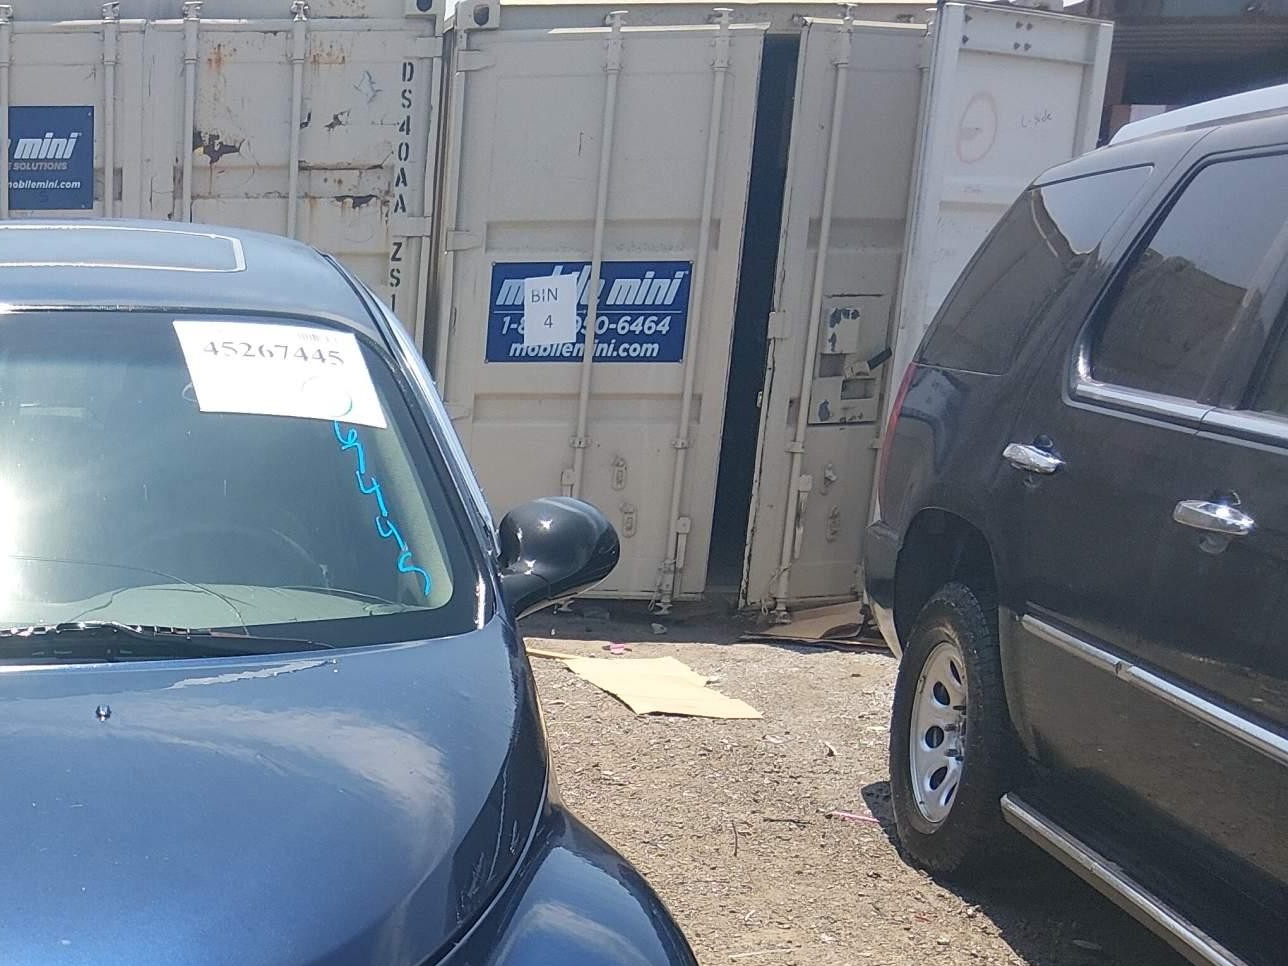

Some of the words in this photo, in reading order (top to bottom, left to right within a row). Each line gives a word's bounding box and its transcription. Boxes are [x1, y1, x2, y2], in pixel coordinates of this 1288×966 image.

[14, 132, 79, 160] mini
[393, 62, 414, 214] DS40AA
[13, 161, 68, 171] SOLUTIONS
[531, 287, 558, 304] BIN
[606, 271, 683, 306] mini
[543, 314, 553, 329] 4
[203, 340, 344, 366] 45267445
